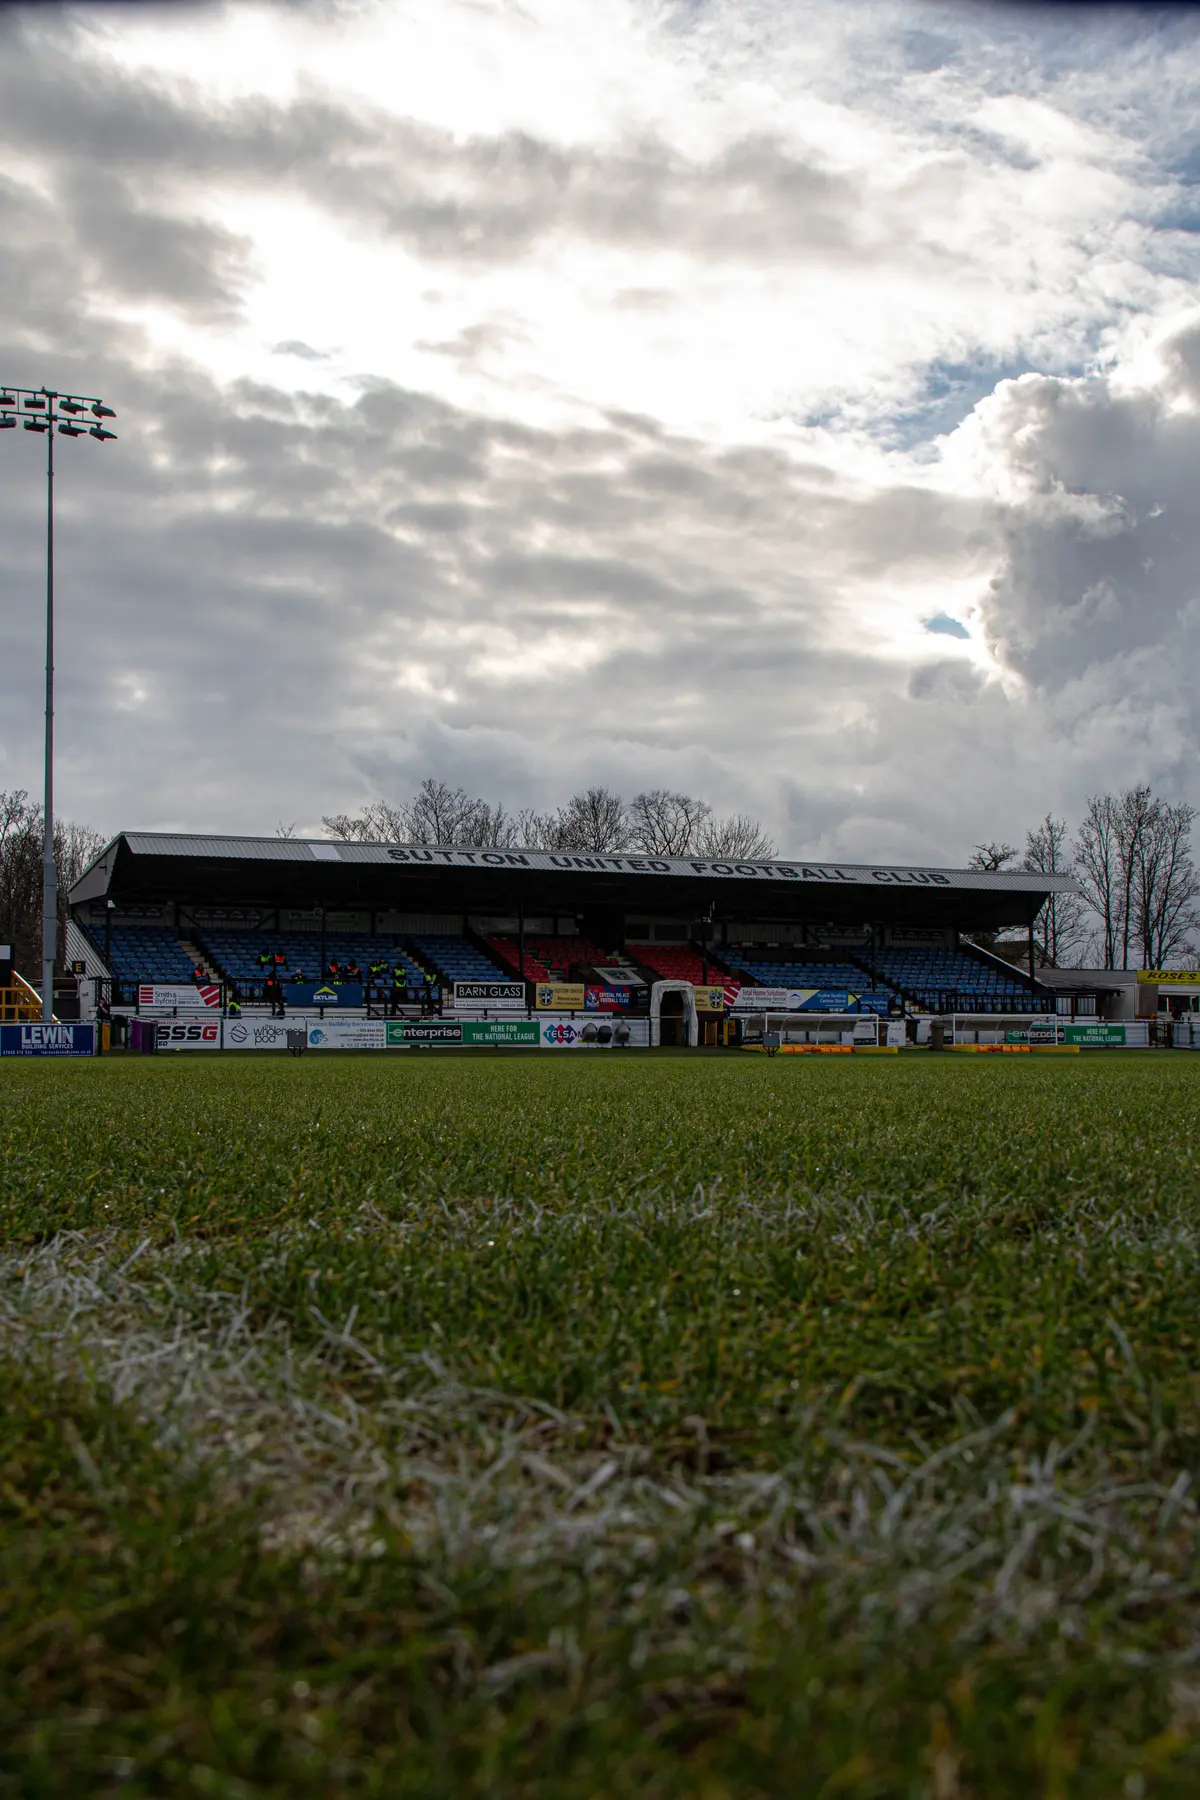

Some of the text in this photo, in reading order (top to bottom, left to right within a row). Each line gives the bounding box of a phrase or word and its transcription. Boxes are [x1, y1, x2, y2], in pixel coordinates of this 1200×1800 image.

[387, 849, 950, 885] SUTTON UNITED FOOTBALL CLUB
[75, 962, 82, 973] E
[1147, 971, 1197, 980] ROSES
[458, 986, 521, 997] BARN GLASS
[21, 1026, 74, 1044] LEWIN
[390, 1027, 461, 1039] enterprise
[545, 1030, 576, 1038] TELSA
